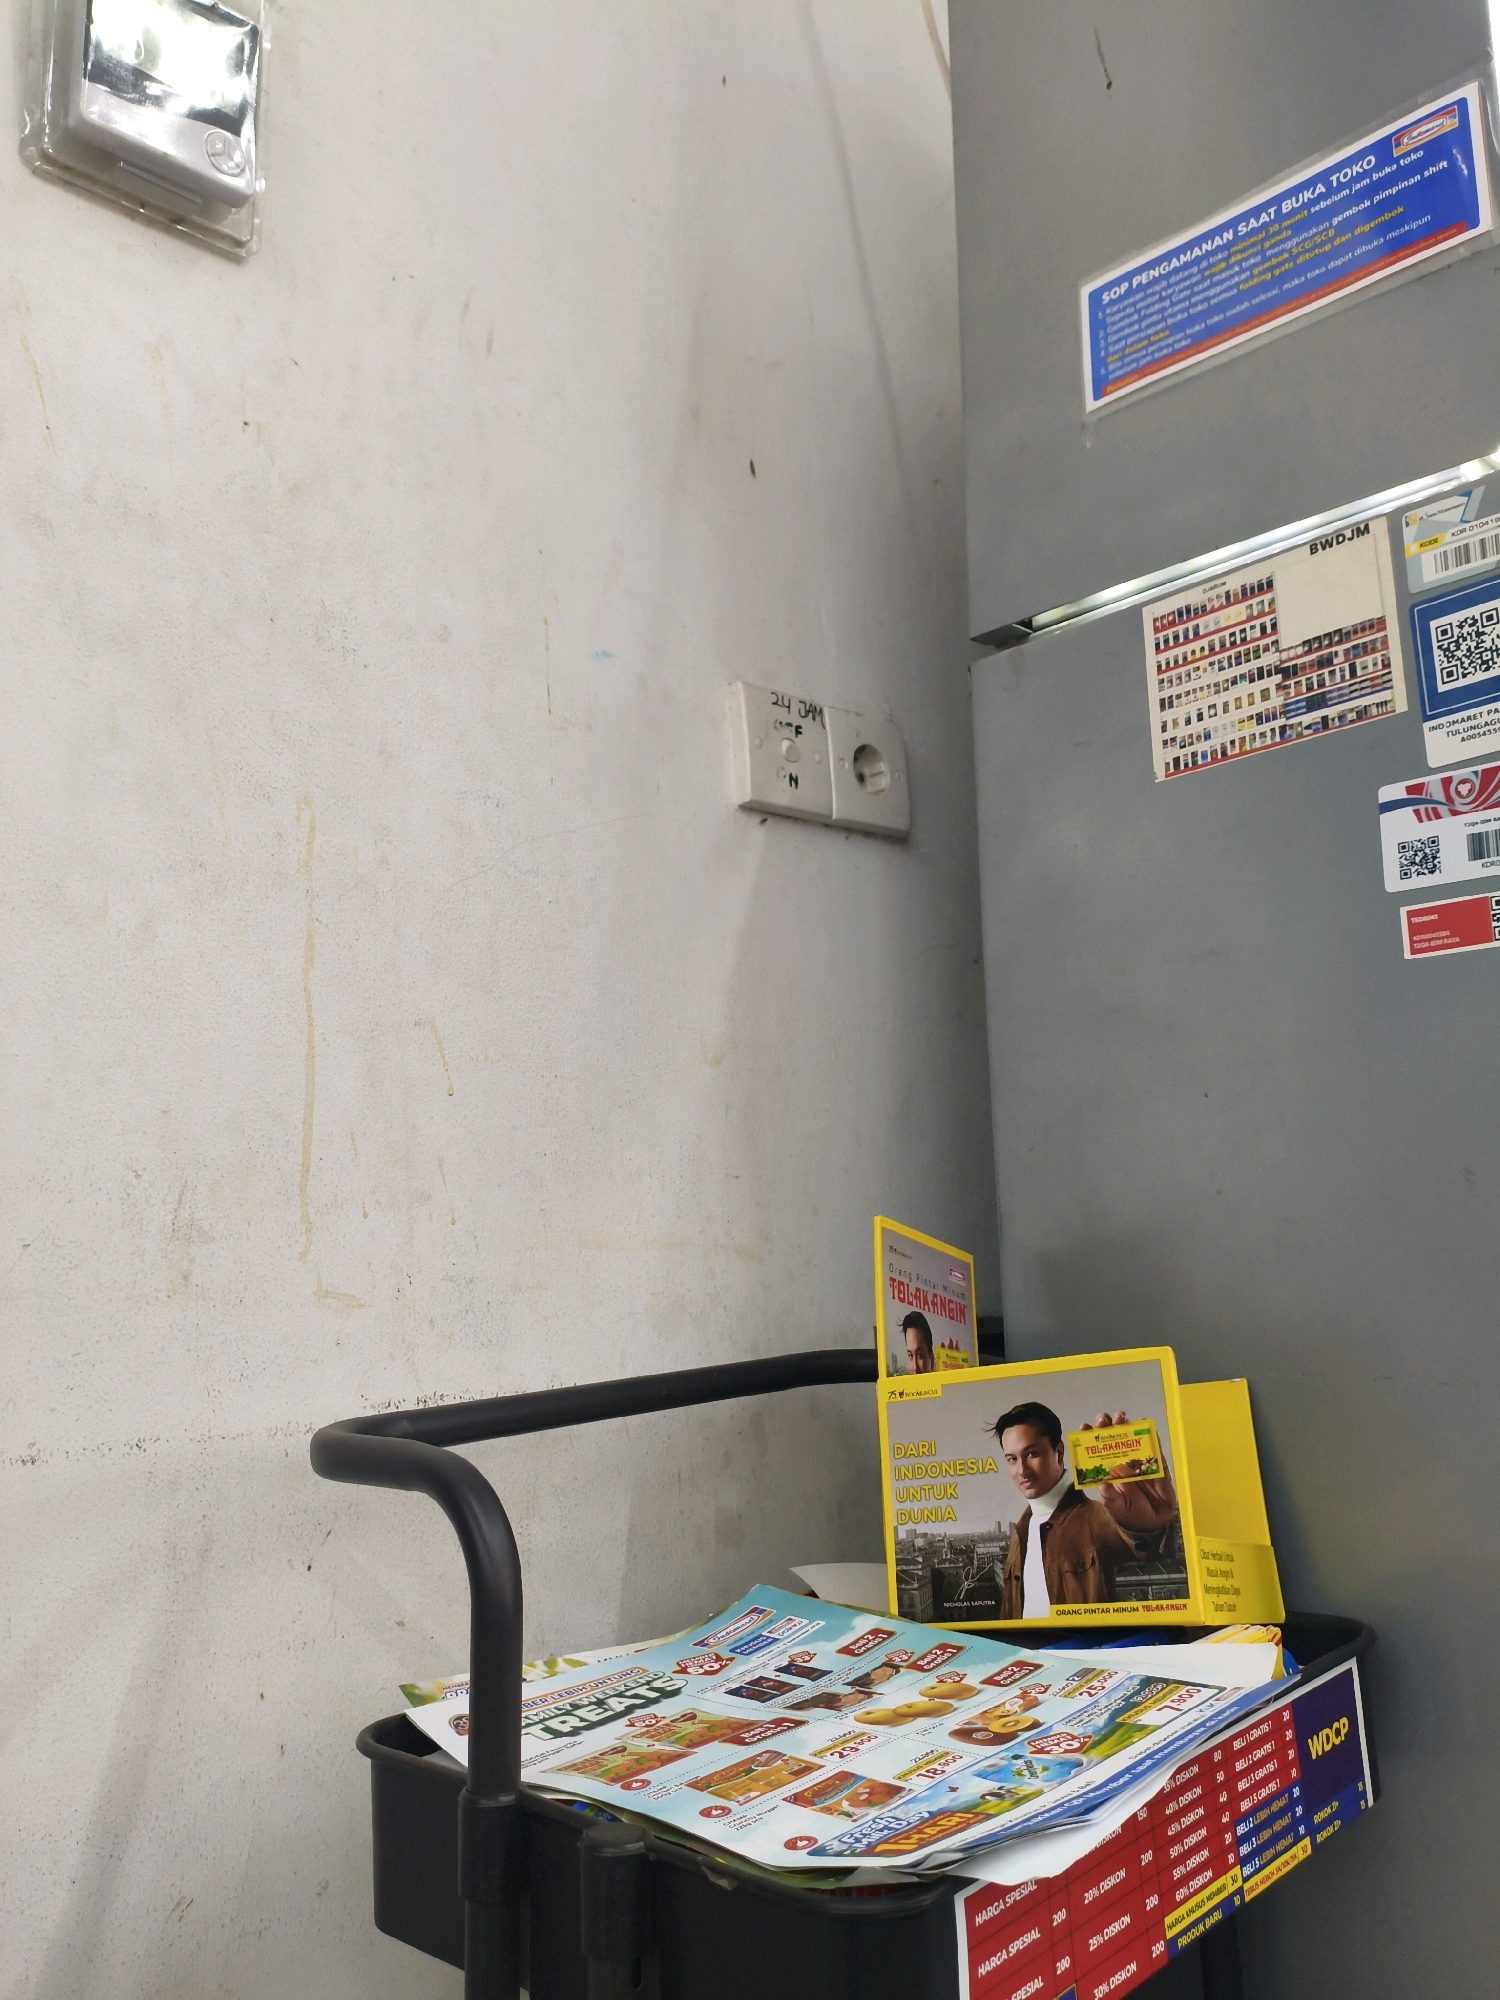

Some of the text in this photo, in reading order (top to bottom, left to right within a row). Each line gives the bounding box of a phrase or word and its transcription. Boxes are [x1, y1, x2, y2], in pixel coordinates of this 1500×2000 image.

[1267, 224, 1279, 235] 30
[1282, 210, 1307, 228] menit
[1310, 187, 1349, 212] sebelum
[1351, 176, 1370, 194] jam
[1372, 162, 1397, 181] buka
[1400, 148, 1423, 167] toko
[1102, 280, 1129, 304] SOP
[1132, 229, 1233, 289] PENGAMANAN
[1237, 207, 1277, 236] SAAT
[1281, 182, 1325, 213] BUKA
[1329, 155, 1376, 188] TOKO
[1242, 254, 1261, 269] toko
[1265, 221, 1329, 259] menggunakan
[1331, 199, 1370, 225] gembok
[1373, 174, 1421, 204] pimpinan
[1423, 159, 1447, 178] shift
[1252, 229, 1335, 276] gembok SCG/SCB
[1263, 229, 1291, 248] ganda
[1273, 261, 1293, 277] gate
[1296, 241, 1331, 264] ditutup
[1333, 231, 1351, 246] dan
[1354, 204, 1404, 236] digembok
[1307, 265, 1325, 279] toko
[1327, 251, 1352, 270] dapat
[1354, 235, 1384, 255] dibuka
[1386, 213, 1431, 241] meskipun
[1309, 523, 1371, 556] BWDJM
[1451, 526, 1467, 538] KDR
[771, 692, 826, 729] 24 JAM
[1429, 712, 1484, 732] INDOMARET
[889, 1263, 912, 1283] Orang
[916, 1273, 939, 1291] Pintar
[943, 1284, 966, 1300] Minum
[893, 1440, 936, 1460] DARI
[894, 1457, 998, 1481] INDONESIA
[895, 1483, 958, 1504] UNTUK
[896, 1505, 957, 1526] DUNIA
[943, 1599, 996, 1609] NICHOLAS SAPUTRA
[1055, 1606, 1083, 1617] ORANG
[1083, 1606, 1111, 1616] PINTAR
[1112, 1604, 1139, 1614] MINUM
[850, 1637, 866, 1651] Beli
[854, 1638, 878, 1655] Gratis
[919, 1653, 933, 1666] Beli
[924, 1654, 946, 1670] Gratis
[686, 1658, 731, 1676] 50%
[993, 1669, 1009, 1682] Beli
[1078, 1671, 1119, 1698] 25.000
[522, 1667, 641, 1710] BER LEBIH UNTUNG
[522, 1704, 576, 1728] AMILY
[574, 1671, 666, 1707] WEEKEND
[523, 1676, 689, 1741] TREATS
[1156, 1687, 1202, 1712] 7.900
[1032, 1734, 1073, 1750] HEMAT
[1049, 1735, 1091, 1755] 30%
[1232, 1709, 1290, 1751] BELI GRATIS 20
[1307, 1716, 1349, 1760] WDCP
[1130, 1756, 1159, 1775] saat
[1175, 1749, 1222, 1787] DISKON 80
[1235, 1729, 1293, 1772] BELI GRATIS 20
[1237, 1748, 1295, 1792] BELI GRATIS 20
[1165, 1770, 1225, 1815] 40% DISKON 50
[1240, 1767, 1297, 1812] BELI GRATIS 10
[843, 1815, 898, 1843] Fresh
[853, 1810, 931, 1849] Milk Day
[898, 1812, 975, 1850] HARI
[1167, 1791, 1228, 1837] 45% DISKON 40
[1236, 1820, 1250, 1837] BELI
[1293, 1786, 1300, 1799] 20
[1239, 1841, 1253, 1857] BELI
[1295, 1805, 1303, 1817] 20
[1313, 1804, 1332, 1825] ROKOK
[1169, 1811, 1230, 1859] 50% DISKON 40
[1242, 1861, 1256, 1878] BELI
[1298, 1824, 1305, 1836] 10
[1316, 1823, 1335, 1844] ROKOK
[1172, 1832, 1232, 1881] 55% DISKON 20
[1084, 1850, 1153, 1905] 20% DISKON 200
[1175, 1852, 1235, 1902] 60% DISKON 10
[1245, 1880, 1260, 1898] TEBUS
[975, 1879, 1038, 1927] HARGA SPESIAL
[1166, 1873, 1238, 1932] HARGA KHUSUS MEMBER 30
[1177, 1894, 1241, 1950] PRODUK BARU 10
[978, 1907, 1067, 1978] HARGA SPESIAL 200
[1088, 1894, 1159, 1952] 25% DISKON 200
[1011, 1955, 1071, 2000] SPESIAL 200
[1093, 1939, 1165, 2000] 30% DISKON 200
